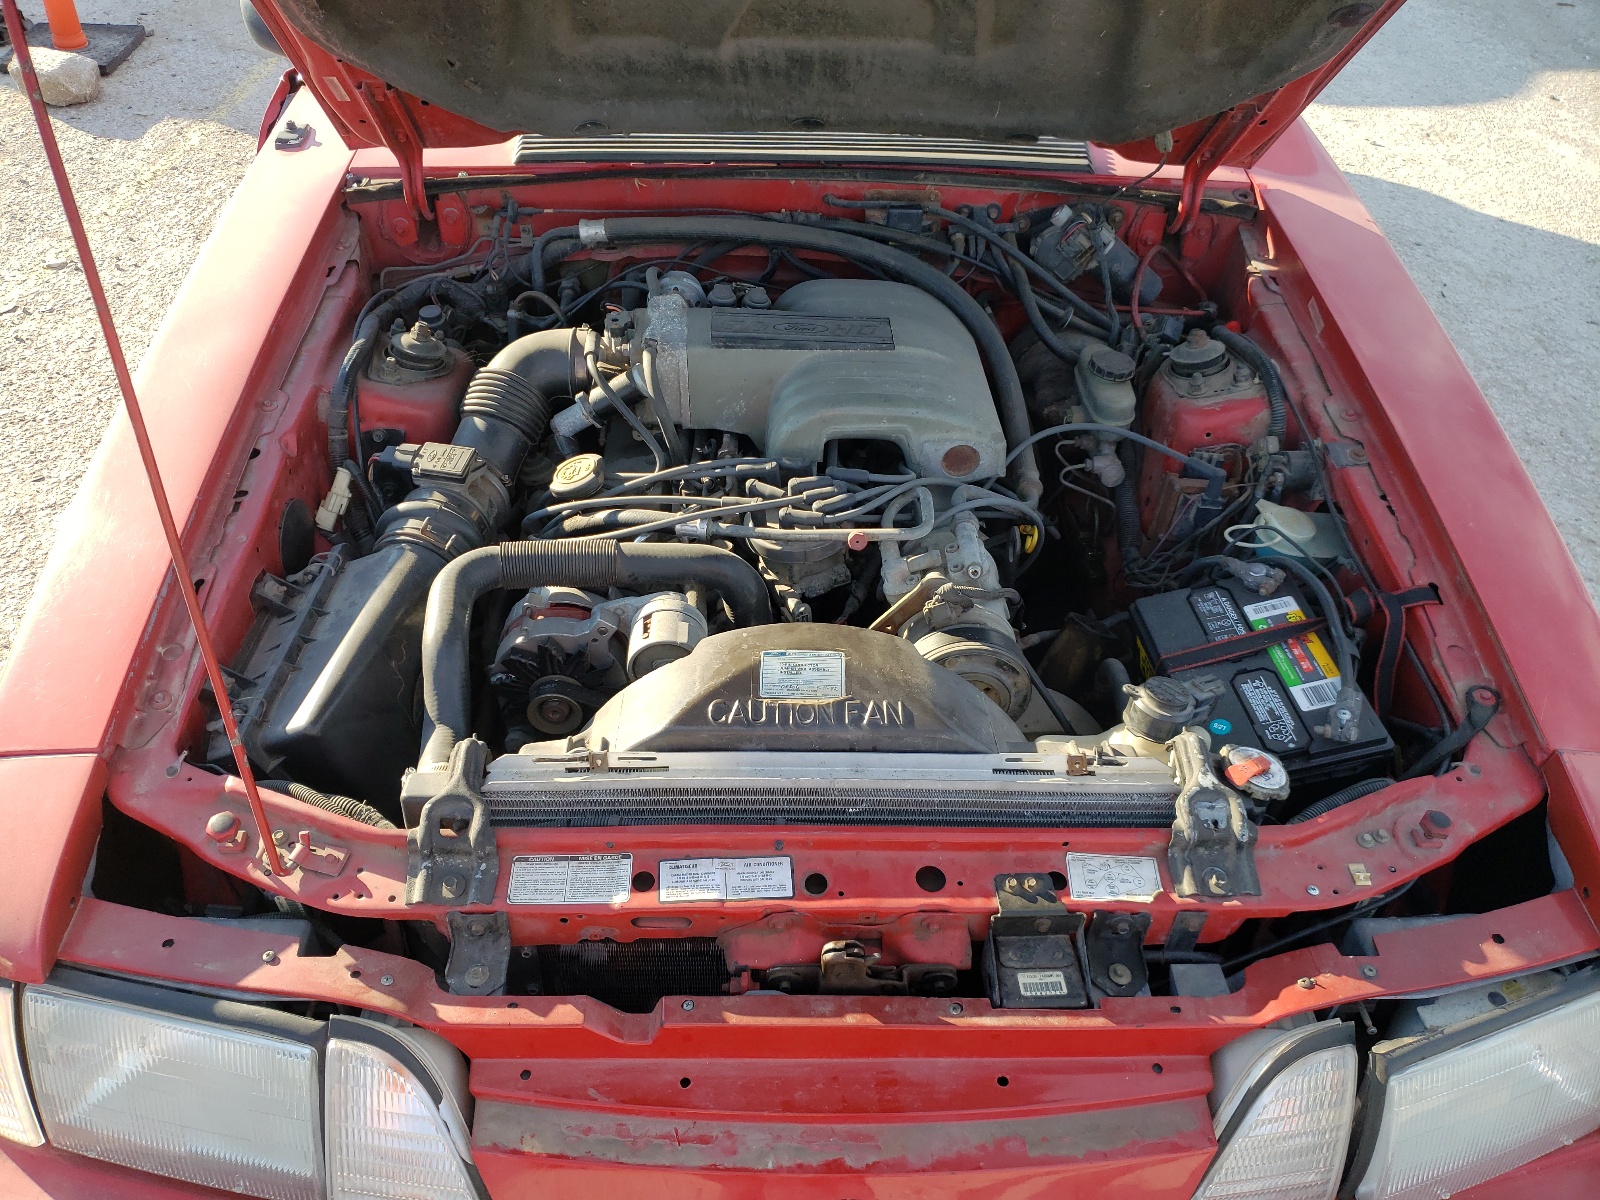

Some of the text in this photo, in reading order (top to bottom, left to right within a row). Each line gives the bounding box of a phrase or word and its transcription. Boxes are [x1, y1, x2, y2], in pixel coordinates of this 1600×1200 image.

[707, 698, 905, 727] CAUTION FAN
[528, 855, 556, 863] CAUTION
